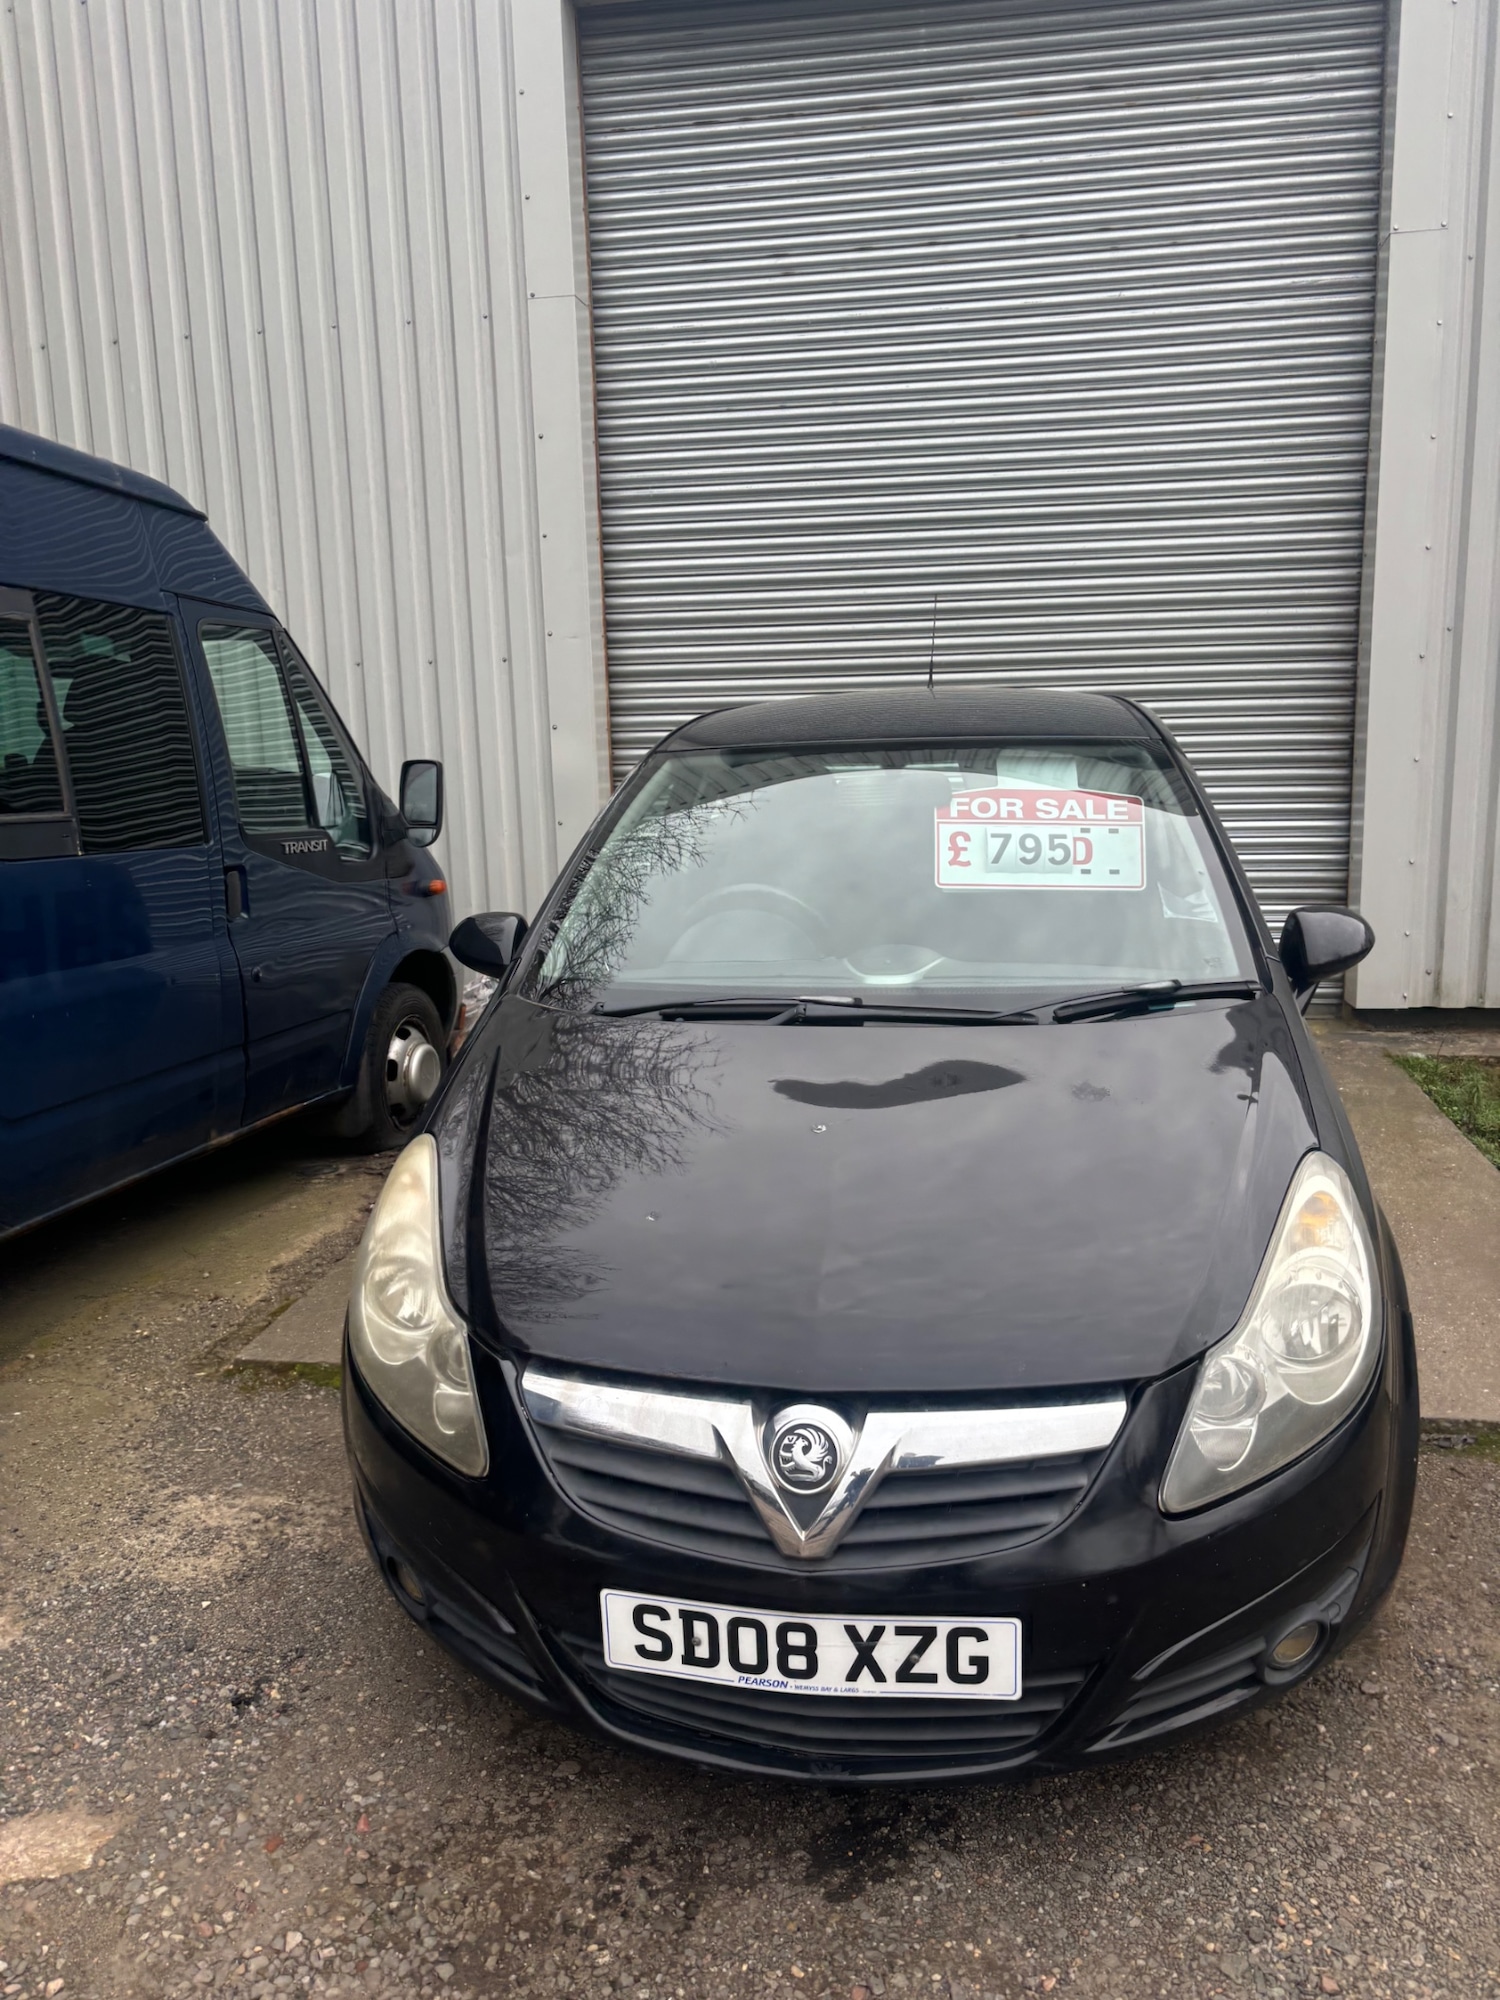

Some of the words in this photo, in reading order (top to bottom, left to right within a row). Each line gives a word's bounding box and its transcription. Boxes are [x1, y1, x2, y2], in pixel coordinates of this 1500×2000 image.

[950, 797, 1024, 818] FOR
[1035, 799, 1129, 820] SALE
[281, 839, 328, 854] TRANSIT
[632, 1604, 819, 1680] SD08
[843, 1625, 990, 1685] XZG
[738, 1675, 789, 1689] PEARSON
